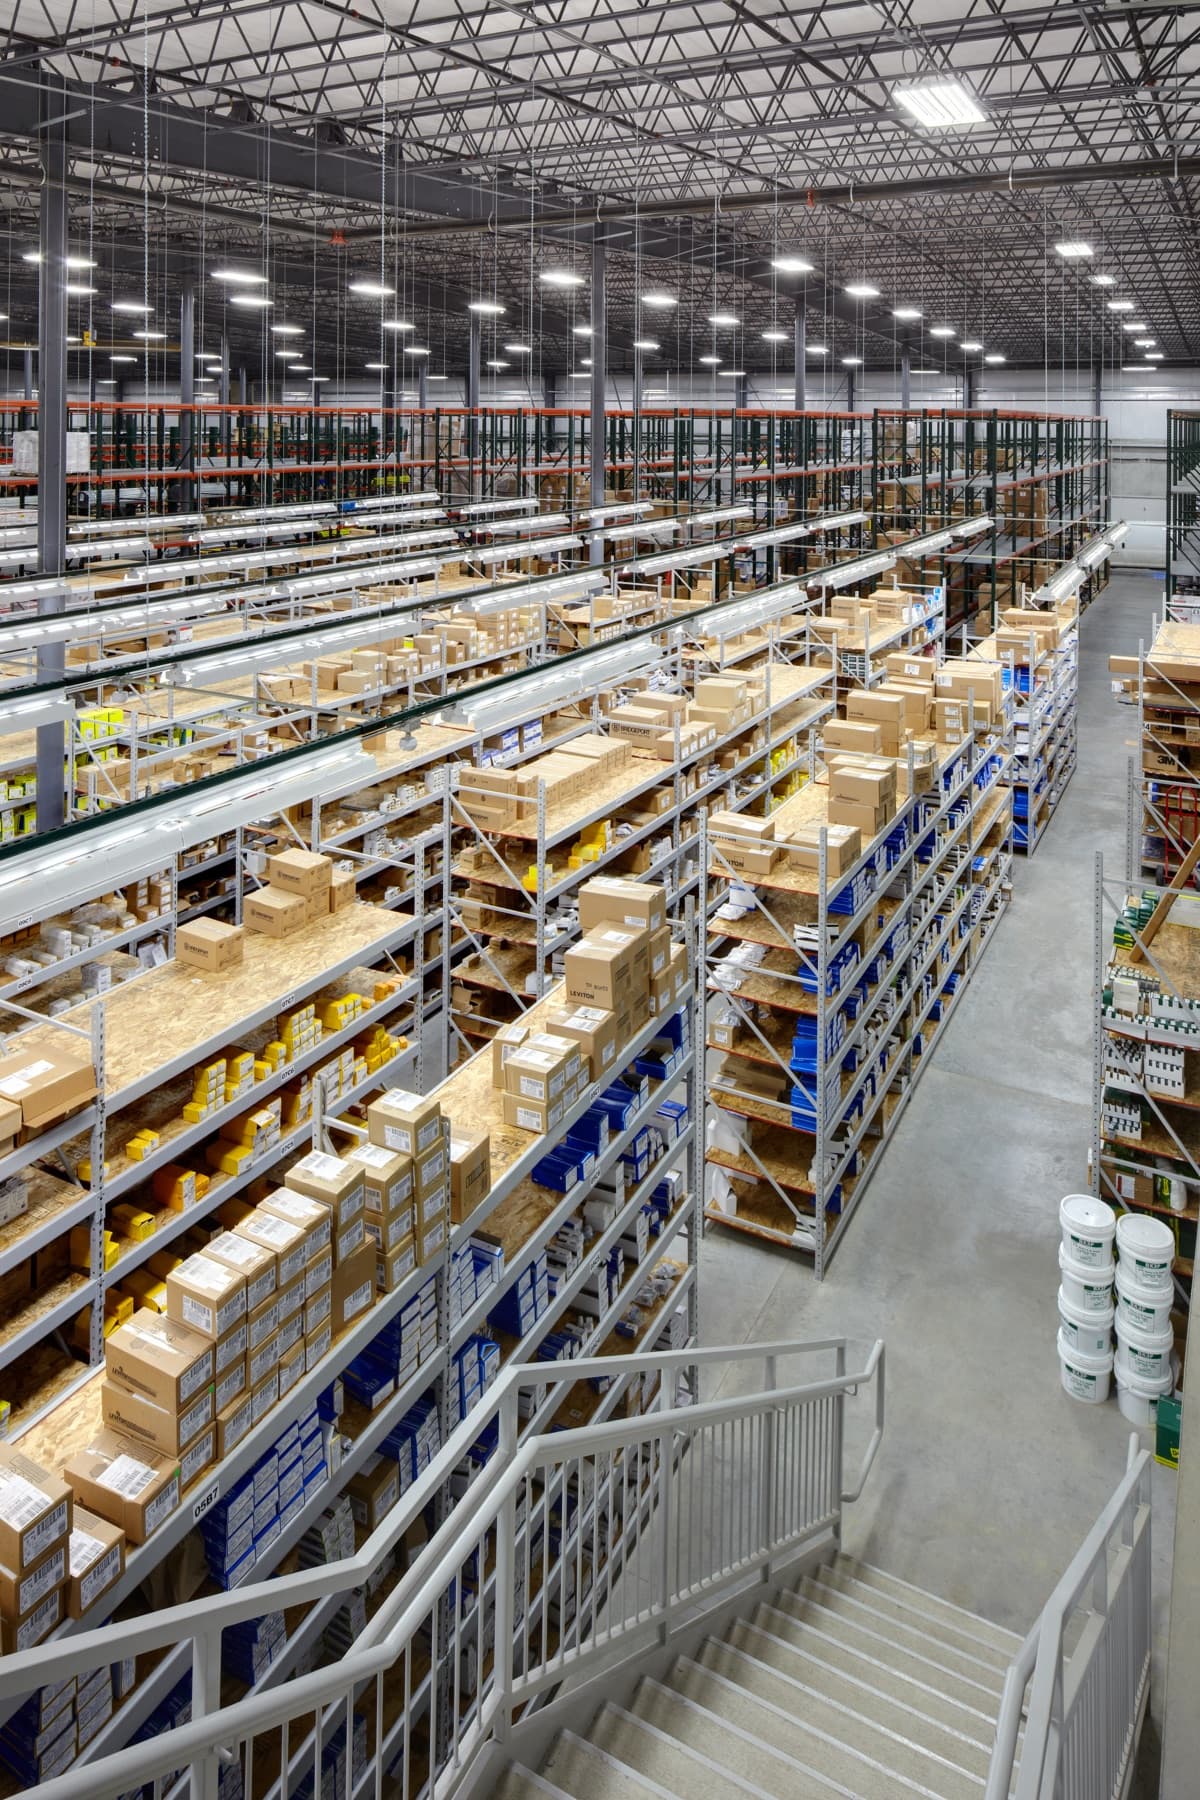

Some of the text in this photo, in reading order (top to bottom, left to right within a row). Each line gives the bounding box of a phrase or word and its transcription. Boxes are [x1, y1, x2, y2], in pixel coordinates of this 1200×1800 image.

[1157, 755, 1175, 765] 3M
[570, 990, 594, 1000] LEVITON
[194, 1486, 218, 1518] 05B7
